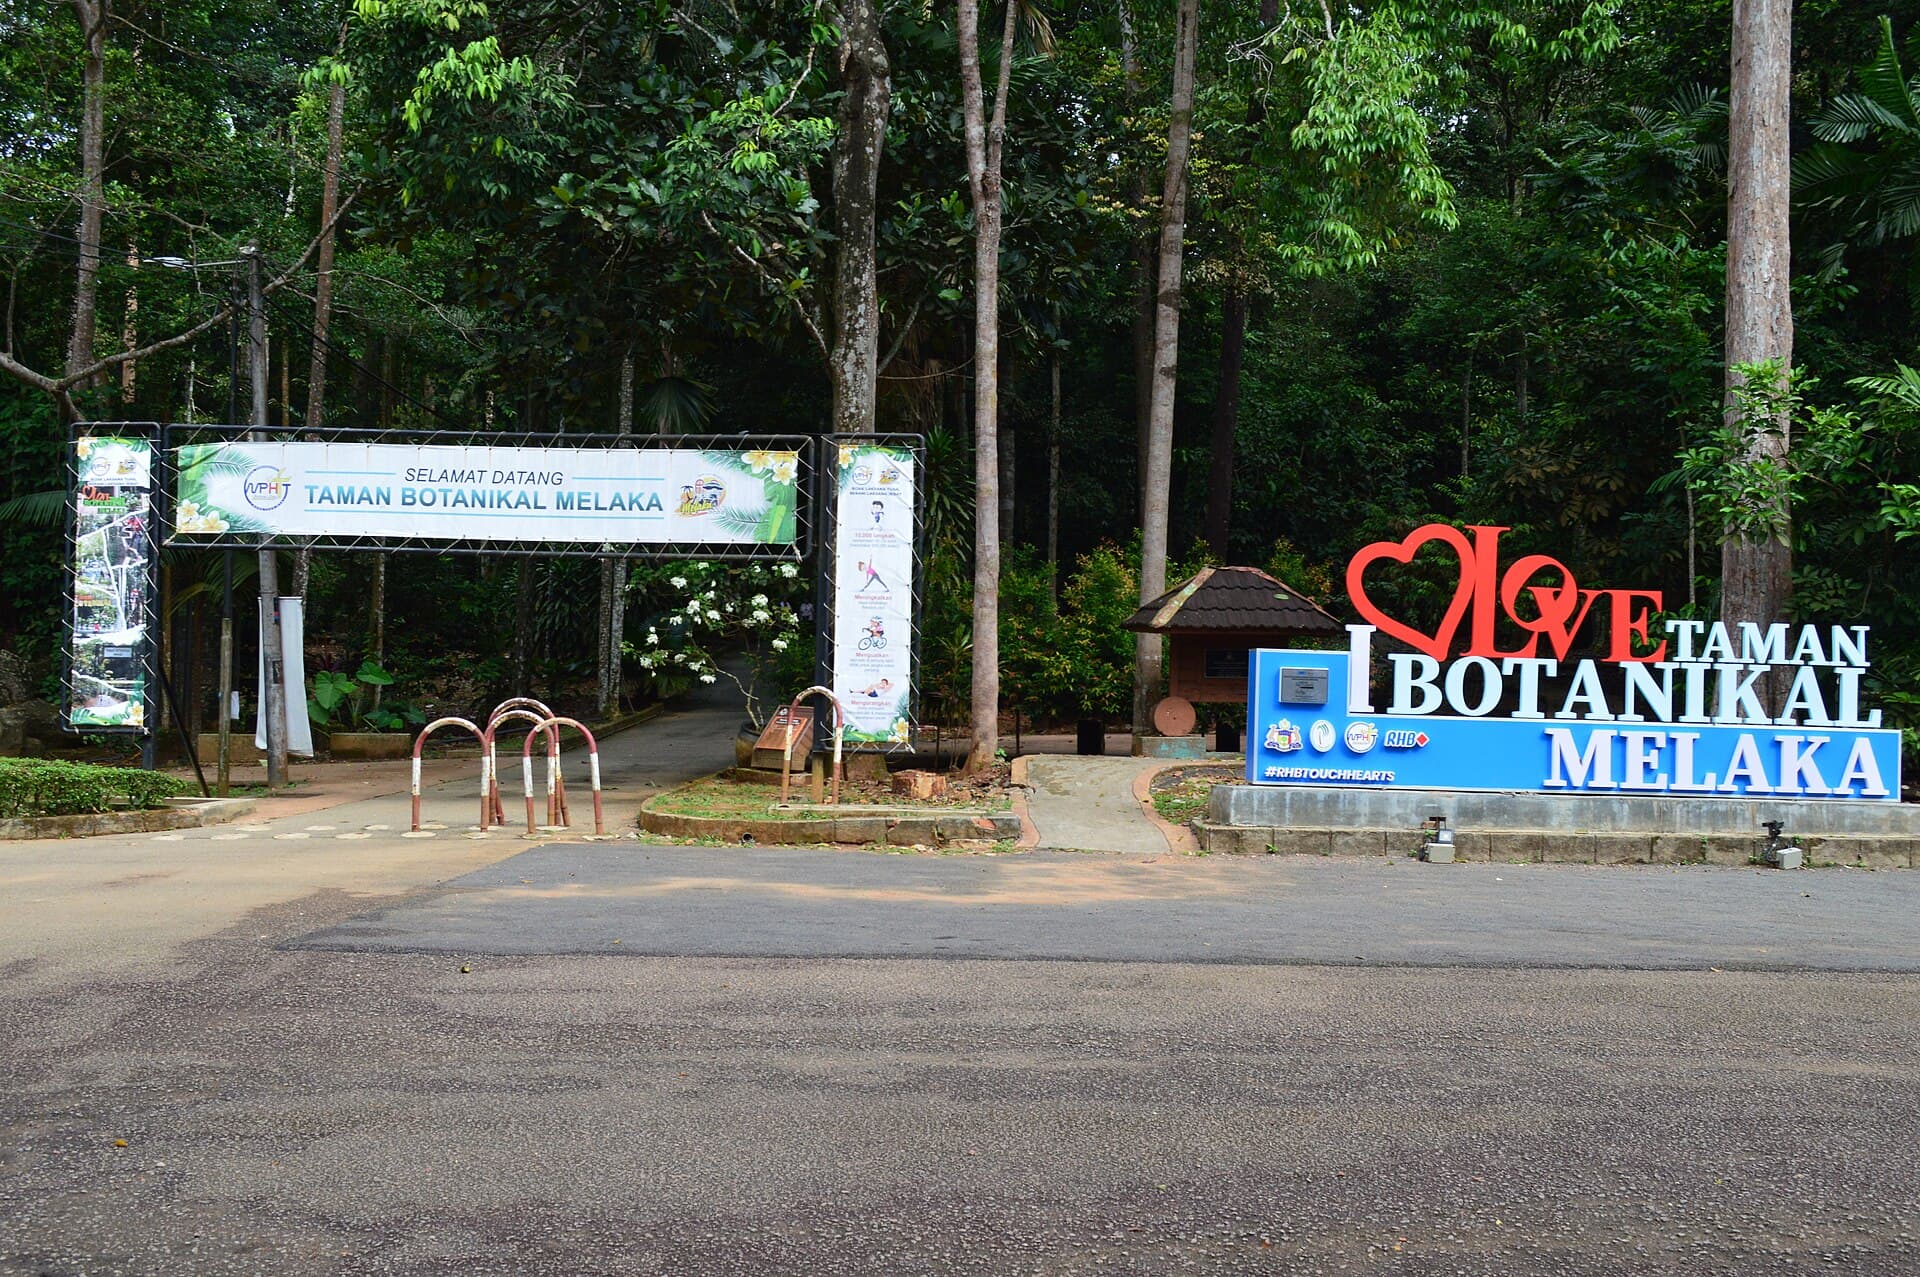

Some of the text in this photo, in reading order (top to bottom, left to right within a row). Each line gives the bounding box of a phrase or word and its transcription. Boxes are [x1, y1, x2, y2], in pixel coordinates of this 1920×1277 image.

[404, 467, 564, 486] SELAMAT DATANG
[304, 485, 663, 512] TAMAN BOTANIKAL MELAKA
[1345, 624, 1377, 713] I
[1665, 619, 1871, 667] TAMAN
[1386, 652, 1882, 728] BOTANIKAL
[1386, 734, 1416, 747] RHB
[1263, 766, 1396, 781] #RHBTOUCHHEARTS
[1543, 728, 1890, 796] MELAKA
